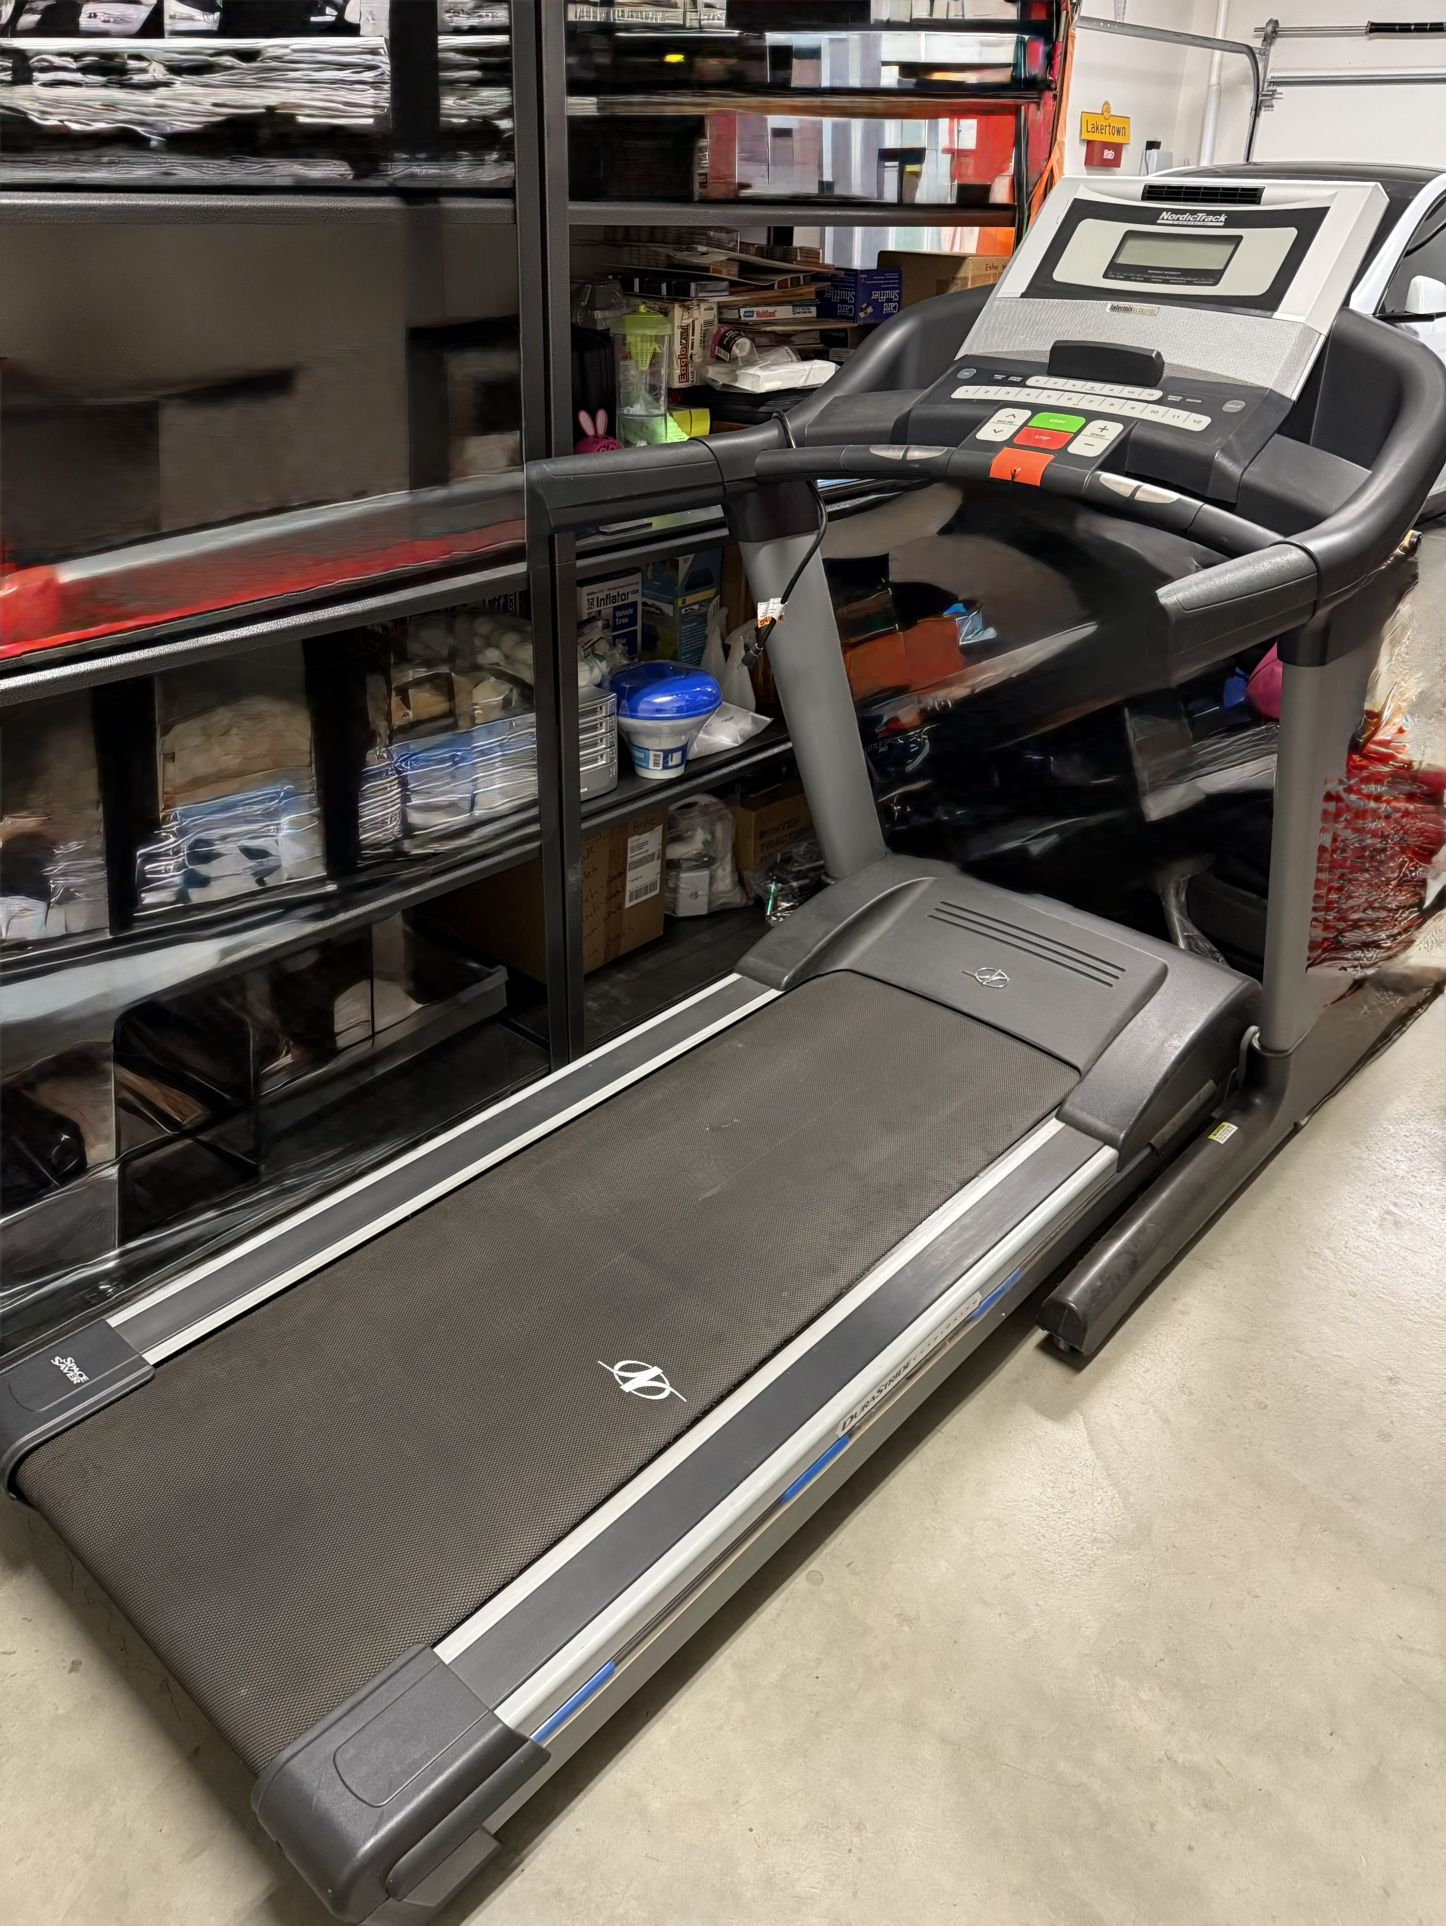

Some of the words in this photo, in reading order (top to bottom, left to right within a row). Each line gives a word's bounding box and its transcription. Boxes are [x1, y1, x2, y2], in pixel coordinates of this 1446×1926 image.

[1086, 119, 1126, 137] Lakertown
[1159, 211, 1228, 222] NordicTrack
[824, 289, 855, 304] Shuffler
[871, 289, 900, 303] Shuffler
[837, 303, 855, 317] Card
[882, 303, 899, 314] Card
[596, 590, 630, 608] Inflator
